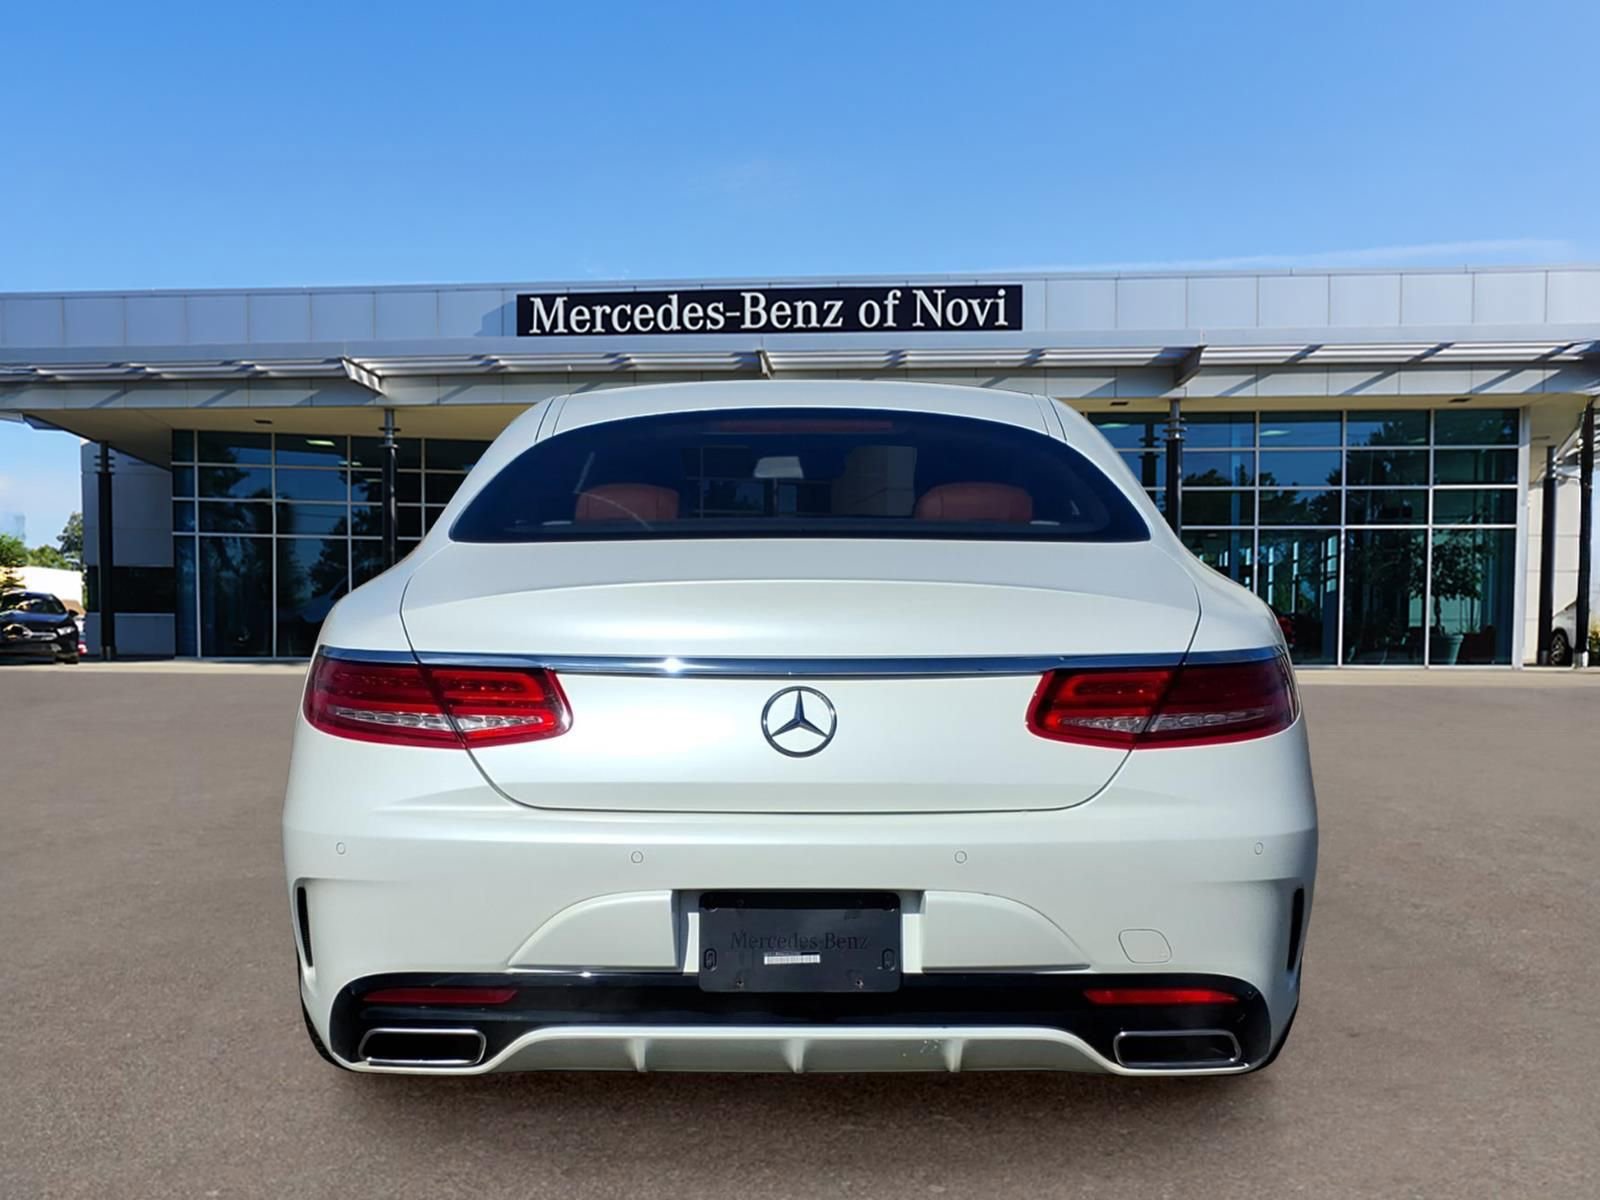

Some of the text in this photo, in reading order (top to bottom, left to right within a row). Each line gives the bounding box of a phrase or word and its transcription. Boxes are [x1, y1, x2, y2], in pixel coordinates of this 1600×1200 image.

[529, 288, 1009, 334] Mercedes-Benz of Novi
